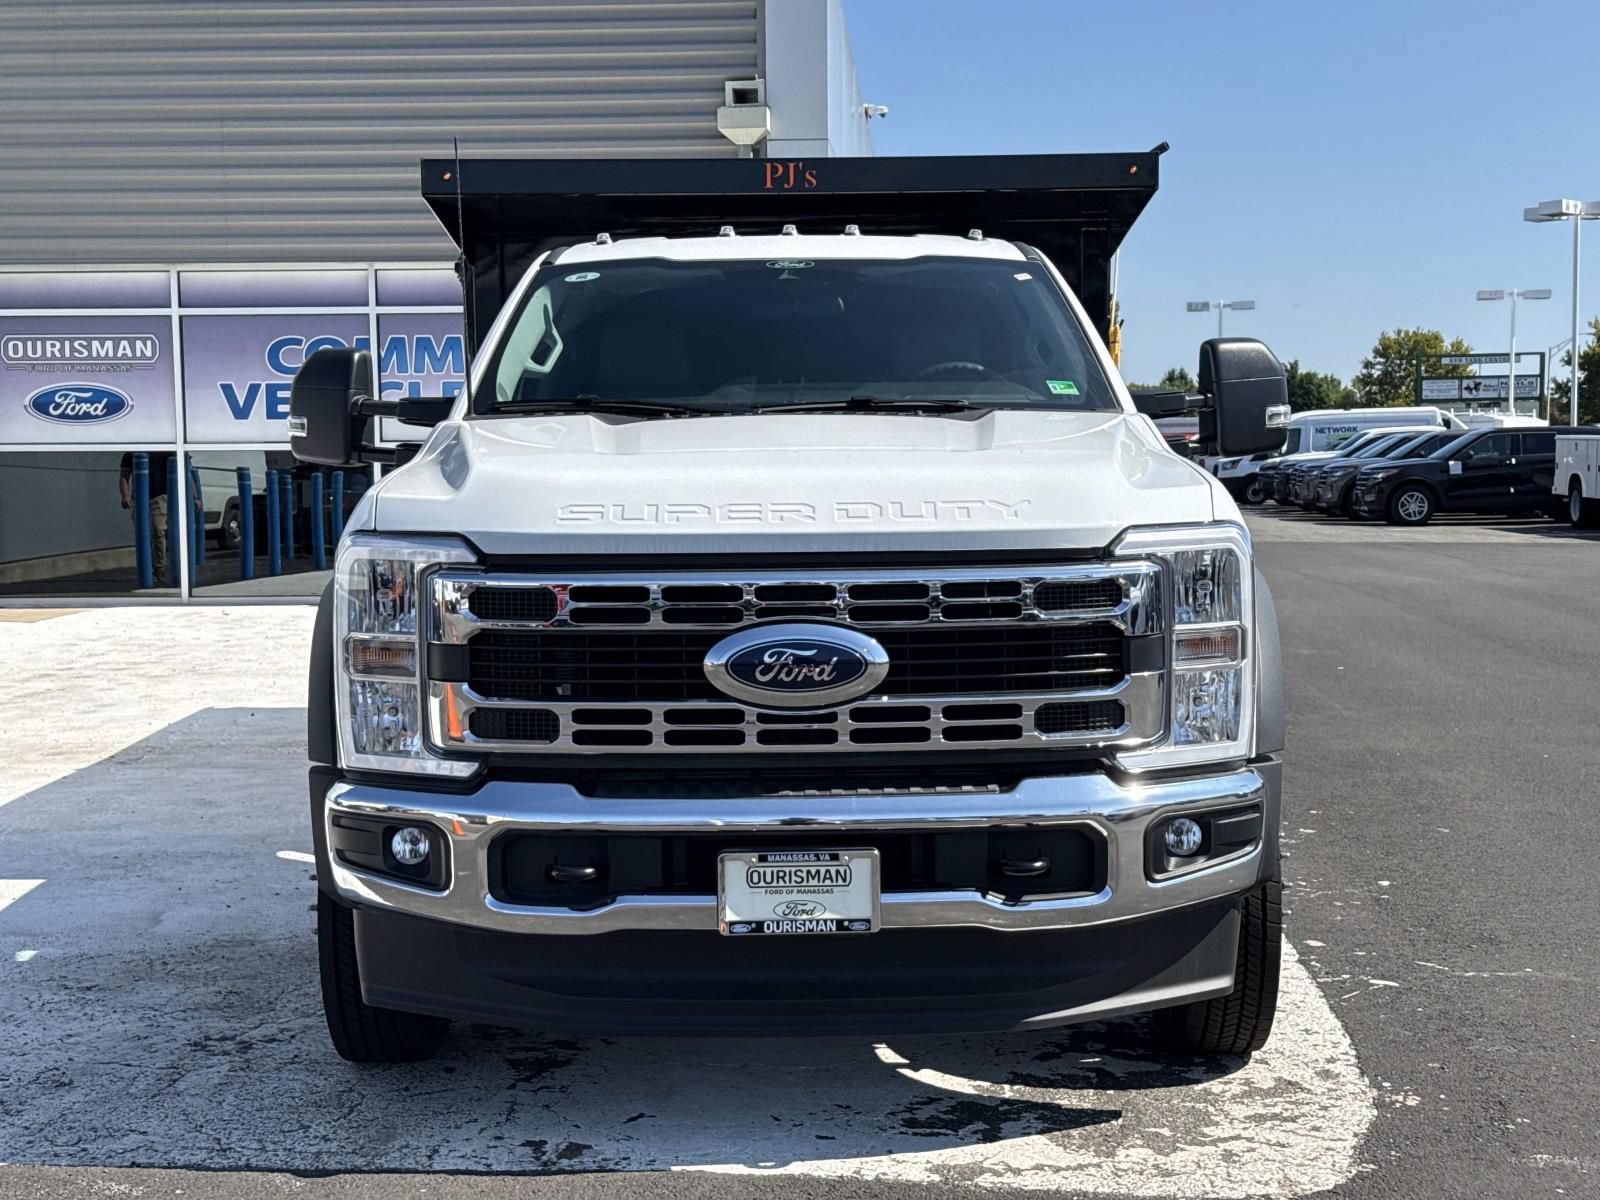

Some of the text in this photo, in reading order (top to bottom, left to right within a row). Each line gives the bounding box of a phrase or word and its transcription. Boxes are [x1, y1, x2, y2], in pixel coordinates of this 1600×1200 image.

[764, 160, 817, 189] PJ's
[7, 339, 153, 358] OURISMAN
[29, 365, 57, 373] FORD
[76, 365, 134, 373] MANASSAS
[49, 391, 107, 416] Ford
[556, 499, 1031, 525] SUPER DUTY
[754, 648, 838, 683] Ford
[750, 868, 848, 885] OURISMAN
[782, 900, 818, 917] Ford
[763, 920, 837, 933] OURISMAN
